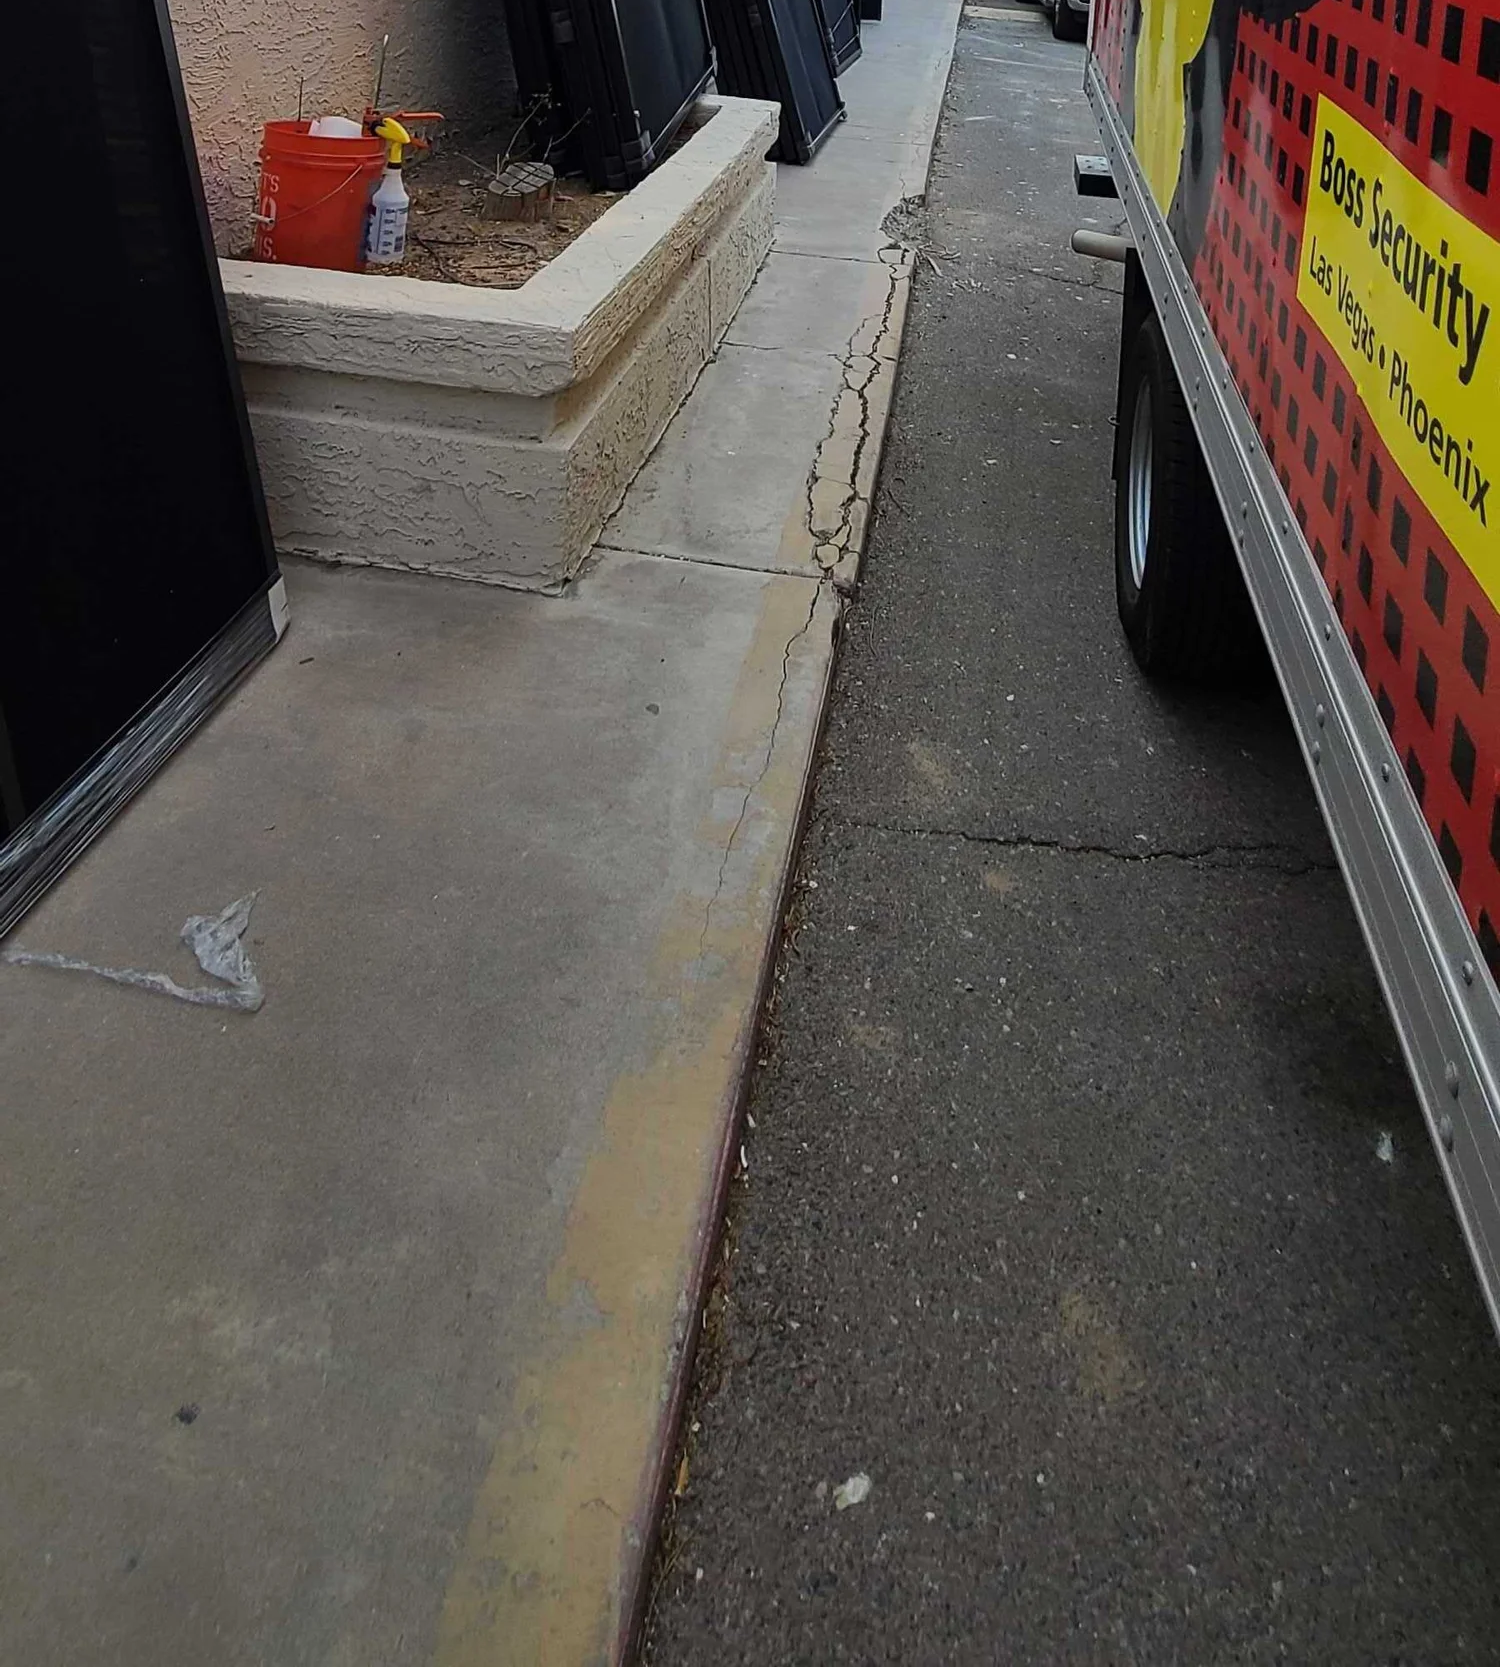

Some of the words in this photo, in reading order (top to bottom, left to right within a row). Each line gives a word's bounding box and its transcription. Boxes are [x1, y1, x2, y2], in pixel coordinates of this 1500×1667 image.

[1310, 235, 1332, 296] Las
[1338, 265, 1375, 363] Vegas
[1389, 349, 1490, 527] Phoenix
[1320, 129, 1365, 228] Boss
[1369, 178, 1490, 385] Security
